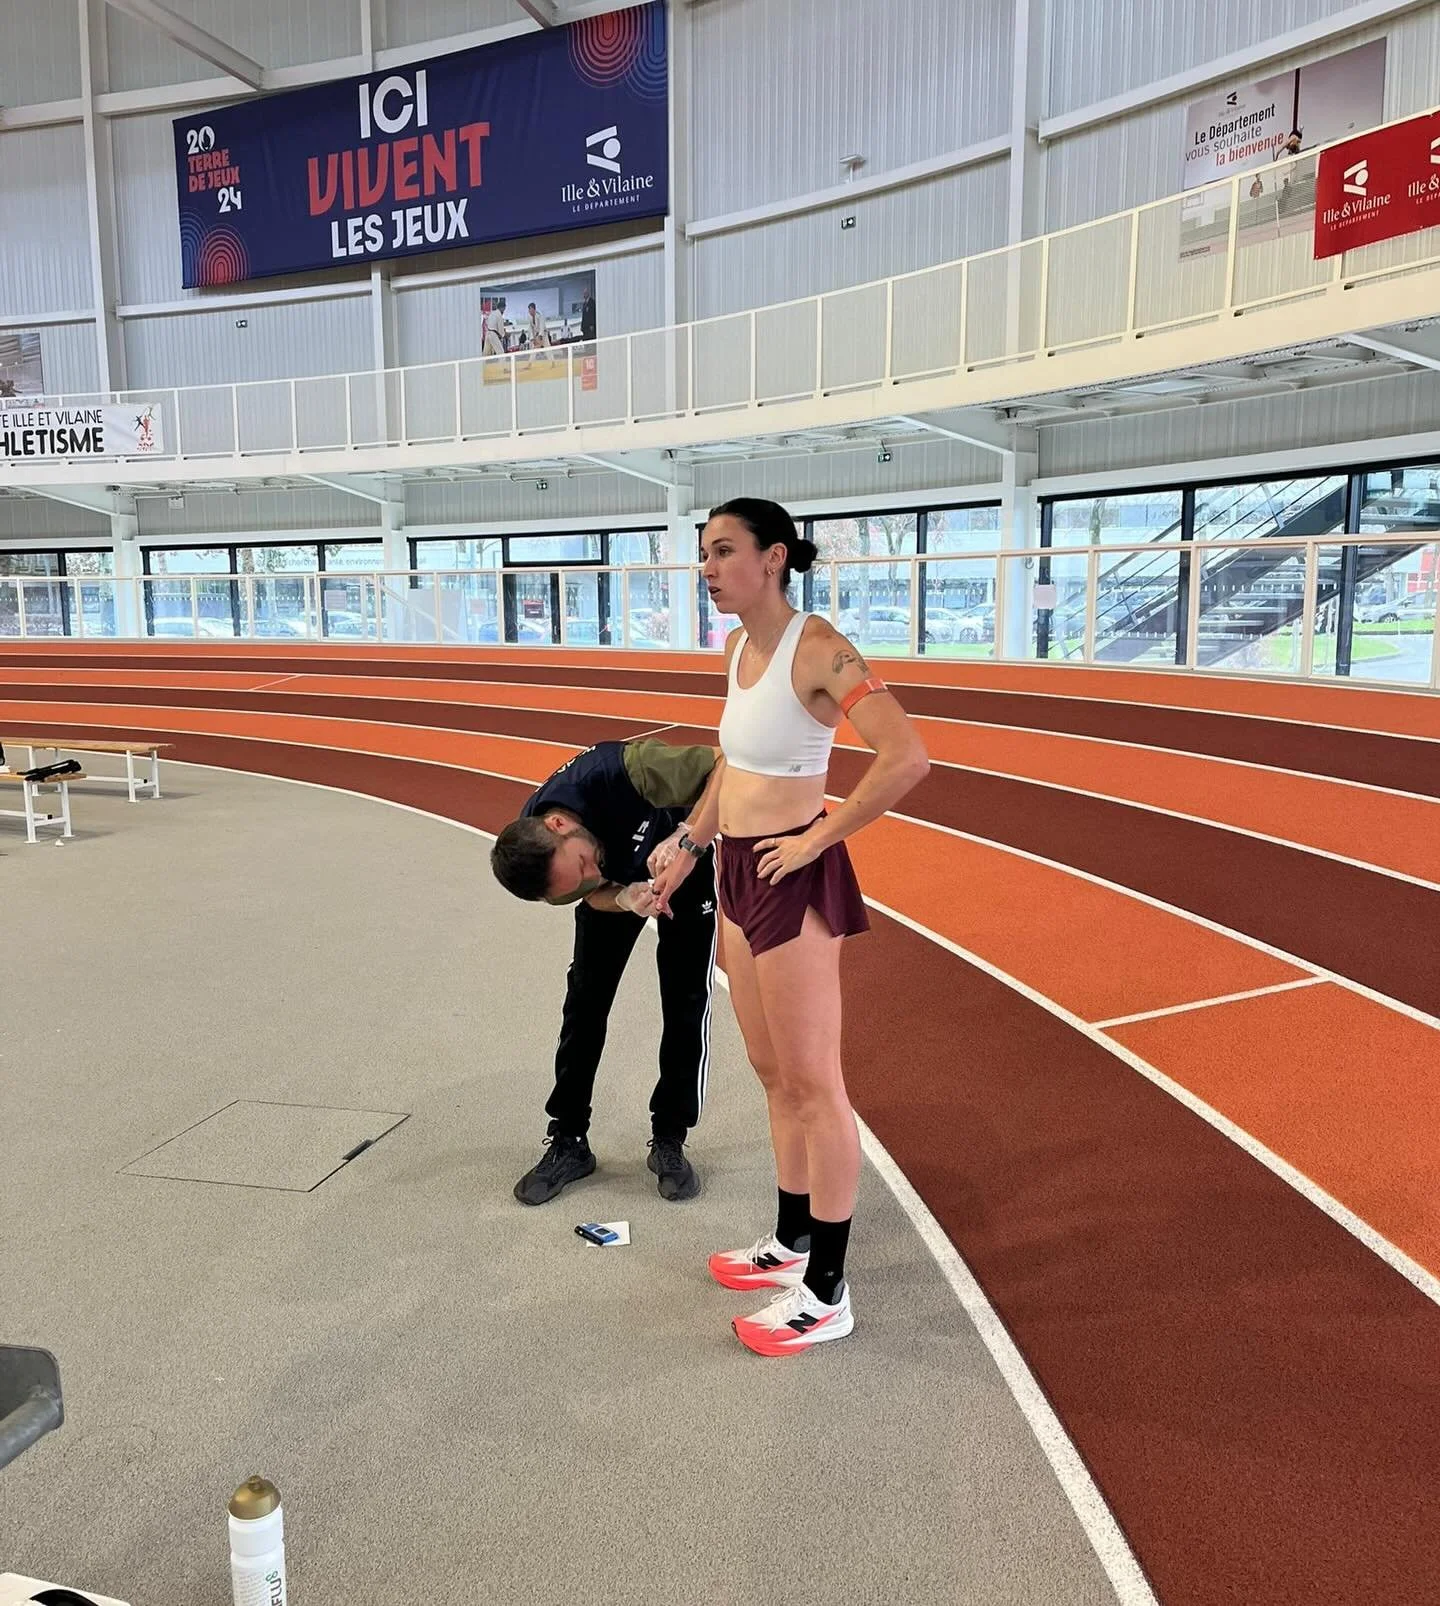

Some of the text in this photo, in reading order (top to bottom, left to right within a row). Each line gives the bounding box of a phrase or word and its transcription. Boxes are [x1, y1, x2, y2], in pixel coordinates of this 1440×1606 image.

[358, 69, 428, 139] ICI
[1195, 131, 1206, 146] Le
[1209, 103, 1276, 141] Département
[186, 125, 215, 155] 20
[1185, 125, 1262, 162] vous souhaite
[1216, 132, 1284, 166] la bienvenue
[188, 148, 229, 173] TERRE
[307, 121, 491, 217] VIVENT
[188, 166, 240, 193] DE JEUX
[561, 174, 654, 202] Ille & Vilaine
[1407, 173, 1439, 198] Ille &
[217, 186, 242, 213] 24
[572, 205, 580, 213] LE
[1323, 193, 1391, 225] Ille & Vilaine
[331, 198, 469, 258] LES JEUX
[0, 409, 104, 428] E ILLE ET VILAINE
[0, 427, 105, 456] HLETISME
